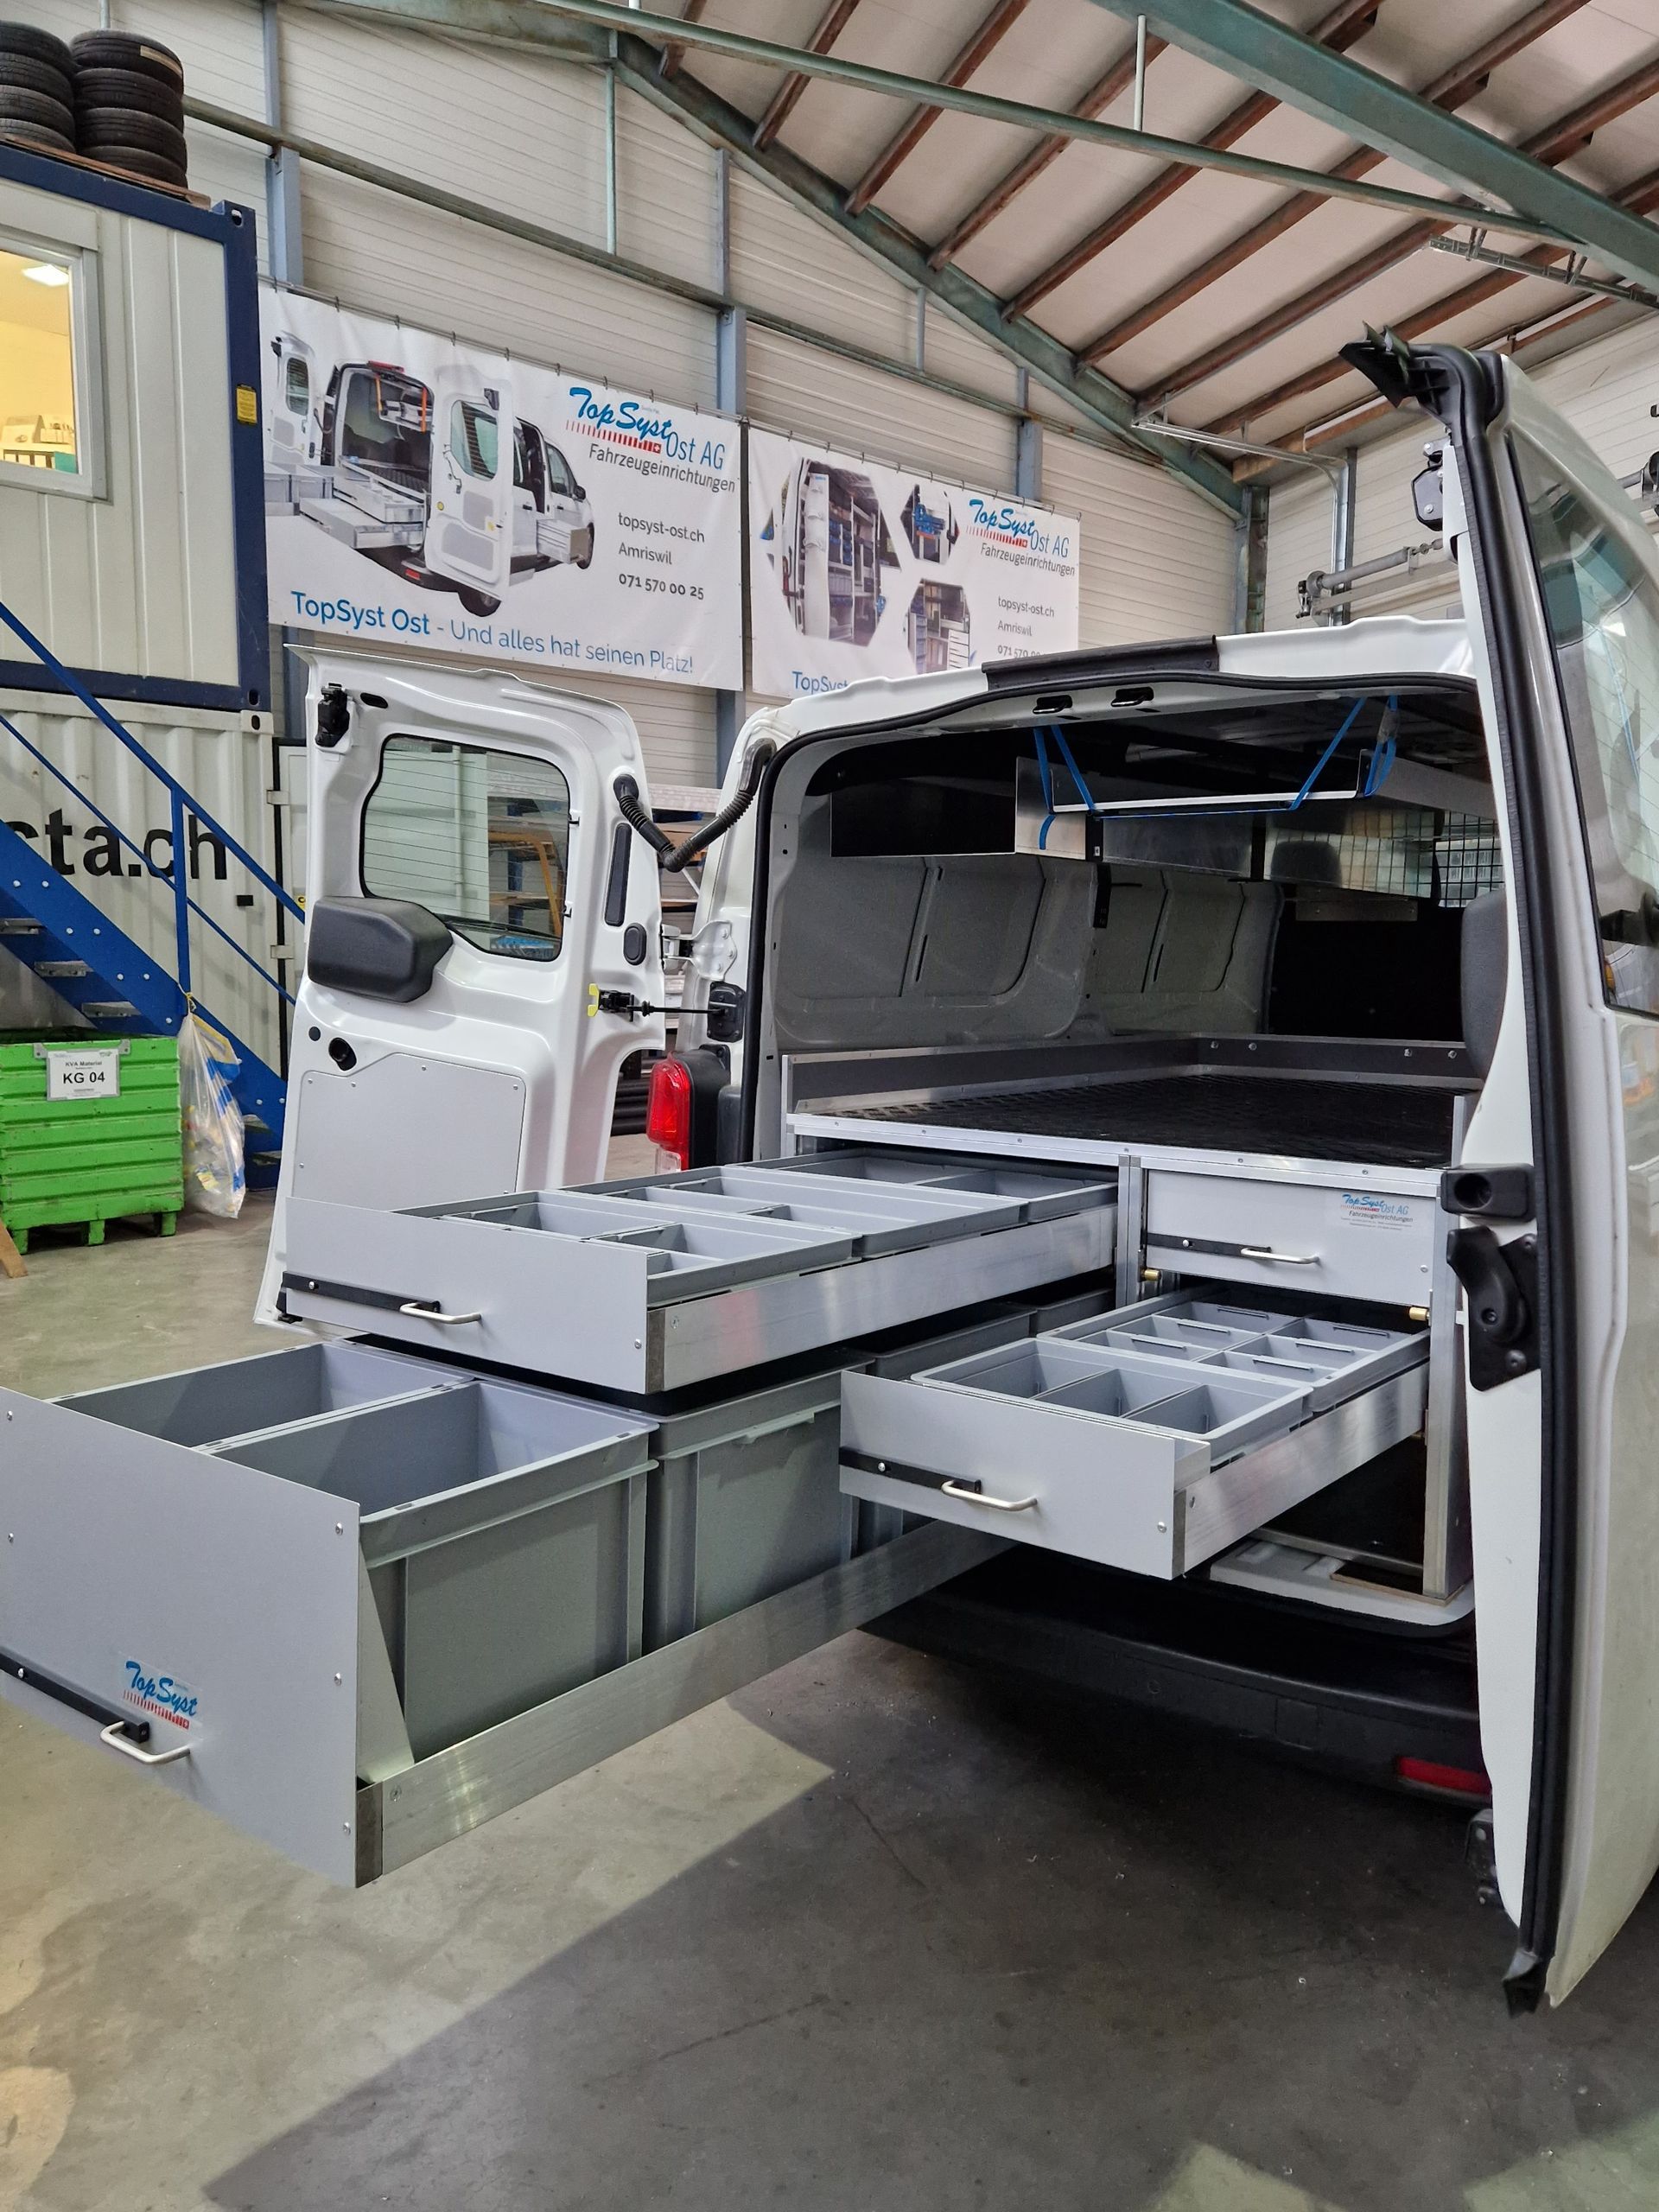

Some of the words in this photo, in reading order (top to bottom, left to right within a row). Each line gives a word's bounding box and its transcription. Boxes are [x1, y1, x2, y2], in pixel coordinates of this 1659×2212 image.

[569, 387, 672, 439] TopSyst
[665, 431, 696, 462] Ost
[700, 441, 726, 470] AG
[588, 443, 735, 493] Fahrzeugeinrichtungen
[618, 512, 705, 543] topsyst-ost.ch
[618, 542, 672, 565] Amriswil
[980, 542, 1075, 577] Fahrzeugeinrichtungen
[1052, 535, 1070, 558] AG
[619, 573, 642, 588] 071
[645, 578, 666, 593] 570
[669, 582, 686, 595] 00
[690, 585, 704, 600] 25
[998, 596, 1055, 618] topsyst-ost.ch
[291, 590, 386, 630] TopSyst
[391, 608, 430, 635] Ost
[450, 619, 493, 646] Und
[498, 626, 545, 653] alles
[550, 635, 582, 658] hat
[586, 644, 645, 667] seinen
[650, 650, 693, 674] Platz!
[997, 620, 1033, 637] Amriswil
[997, 645, 1012, 658] 071
[6, 808, 226, 880] ta.ch
[63, 1072, 85, 1084] KG
[89, 1071, 105, 1083] 04
[1349, 1211, 1413, 1223] Fahrzeugeinrichtungen
[126, 1661, 198, 1716] TopSyst
